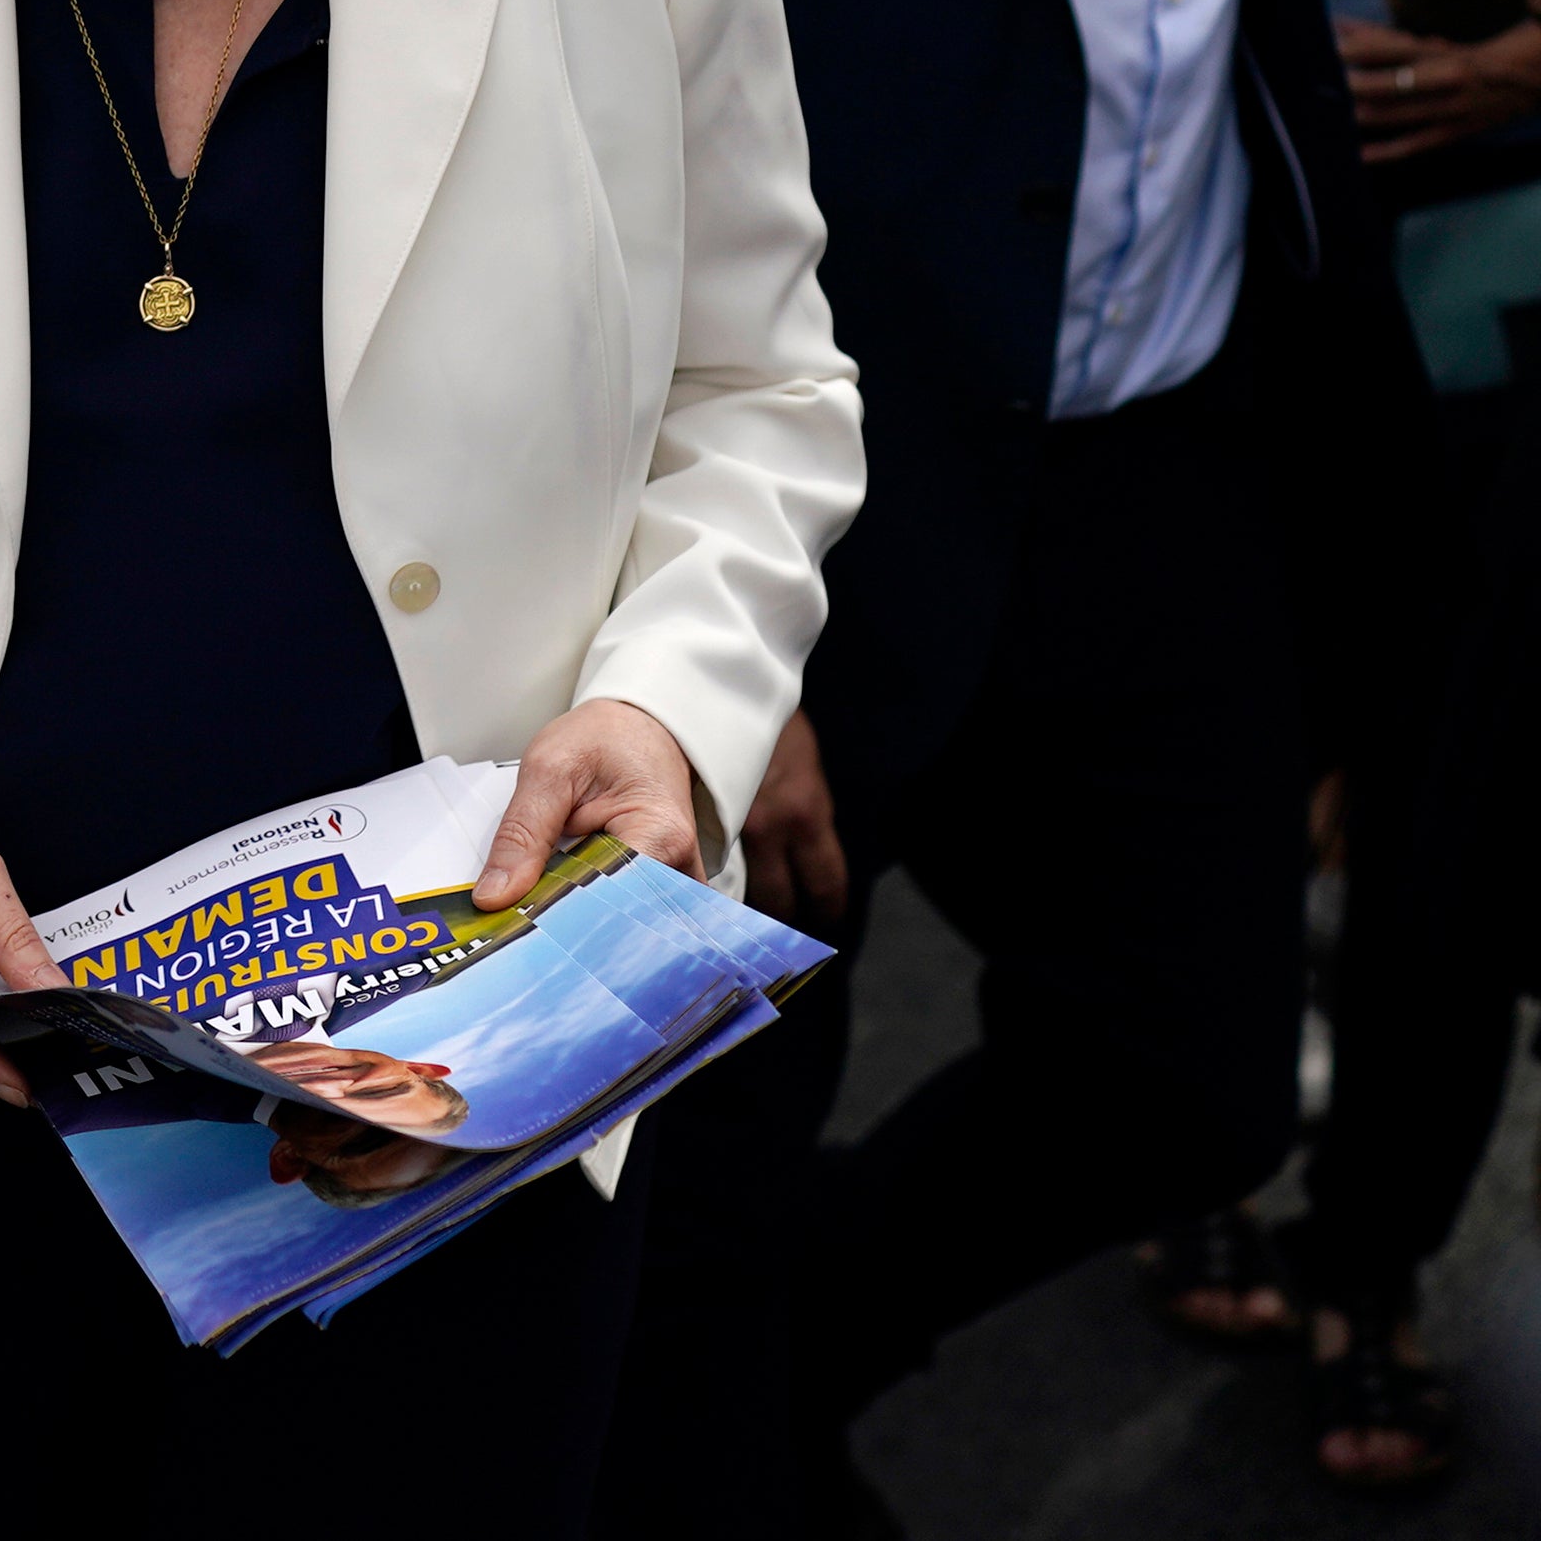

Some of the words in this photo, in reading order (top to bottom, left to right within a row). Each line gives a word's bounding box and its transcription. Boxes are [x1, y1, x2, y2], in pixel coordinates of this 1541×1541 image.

[231, 815, 319, 854] National
[167, 827, 326, 897] Rassemblement
[68, 918, 114, 942] droite
[72, 862, 340, 988] DEMAIN
[325, 893, 385, 929] LA
[136, 908, 314, 998] RÉGION
[149, 919, 440, 1013] CONSTRUIS
[334, 937, 494, 999] Thierry
[201, 988, 328, 1036] MA
[340, 982, 401, 1009] avec
[73, 1056, 169, 1098] NI
